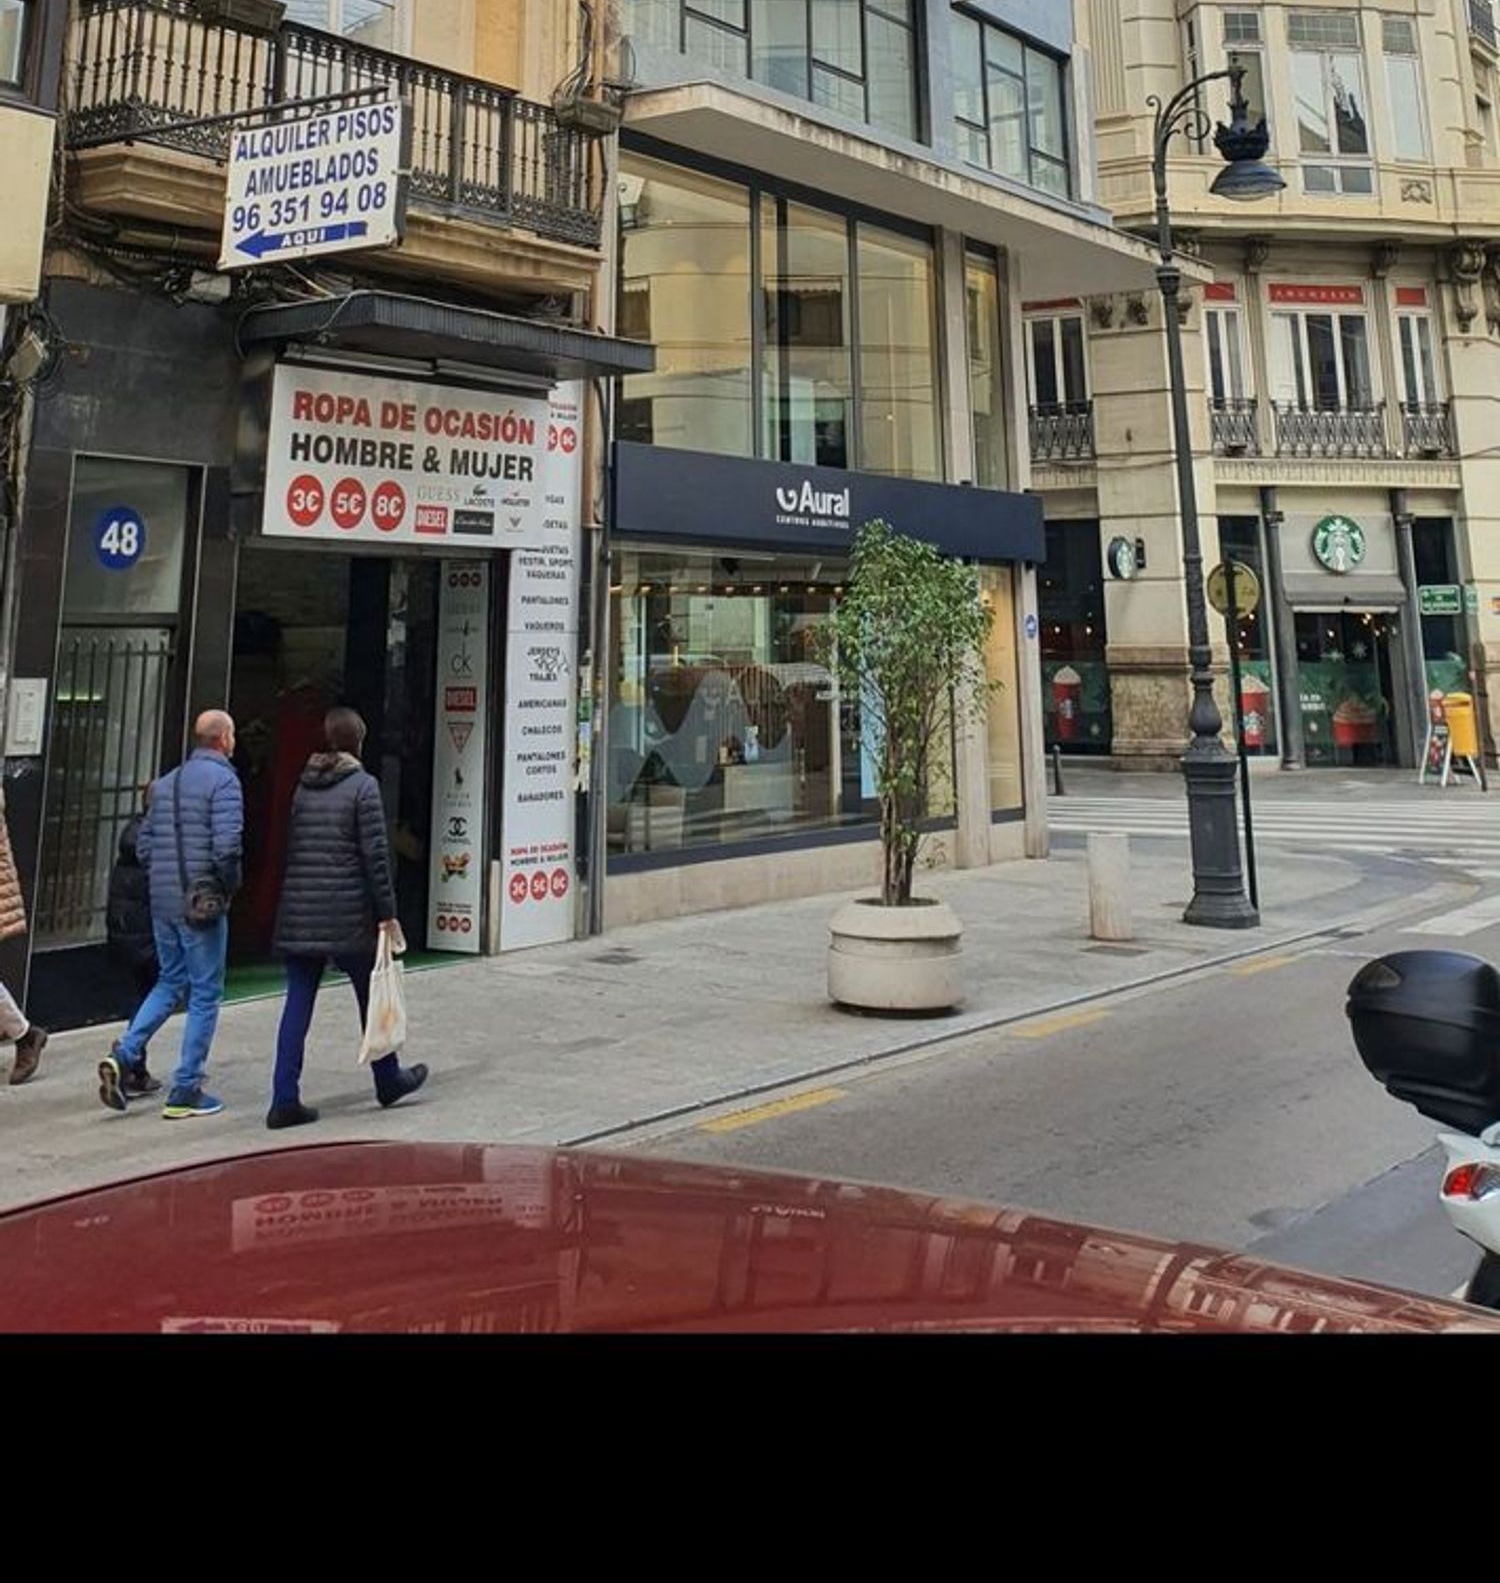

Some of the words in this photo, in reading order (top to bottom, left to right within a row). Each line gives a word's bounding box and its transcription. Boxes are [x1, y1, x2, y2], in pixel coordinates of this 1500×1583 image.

[235, 119, 330, 161] ALQUILER
[337, 106, 394, 143] PISOS
[245, 148, 378, 197] AMUEBLADOS
[233, 203, 260, 232] 96
[269, 195, 310, 227] 351
[320, 188, 349, 218] 94
[358, 182, 387, 211] 08
[281, 228, 326, 249] AQUI
[293, 391, 371, 428] ROPA
[381, 402, 416, 431] DE
[424, 409, 535, 445] OCASIÓN
[290, 432, 414, 471] HOMBRE
[422, 446, 441, 474] &
[449, 448, 534, 482] MUJER
[292, 489, 319, 512] 3€
[336, 492, 363, 514] 5€
[376, 494, 401, 517] 8€
[799, 480, 850, 517] Aural
[101, 520, 138, 555] 48
